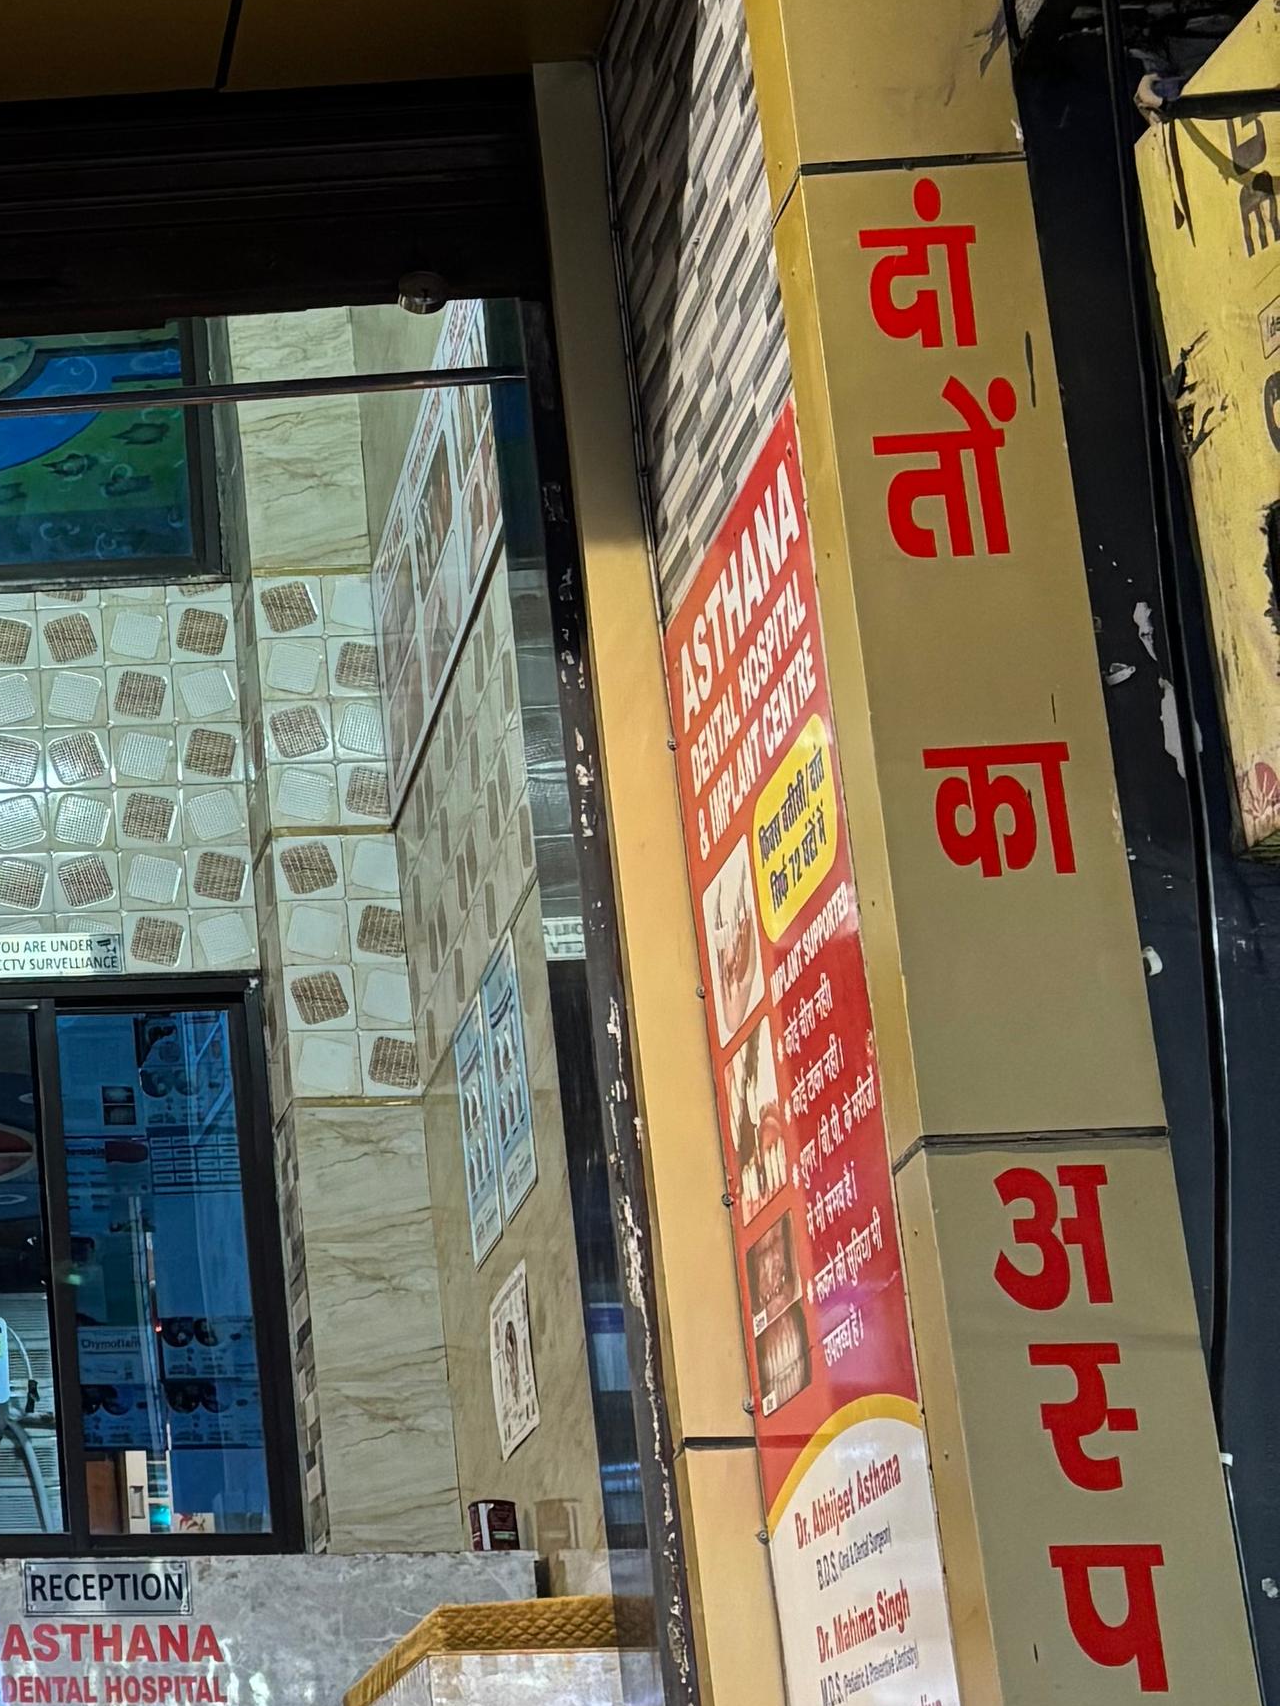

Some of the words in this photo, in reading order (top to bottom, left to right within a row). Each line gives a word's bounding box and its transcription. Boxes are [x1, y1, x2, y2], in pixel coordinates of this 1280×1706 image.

[680, 460, 800, 733] ASTHANA
[690, 684, 740, 797] DENTAL
[738, 570, 806, 716] HOSPITAL
[697, 808, 710, 861] &
[708, 718, 761, 844] IMPLANT
[762, 632, 816, 759] CENTRE
[923, 741, 1078, 878] का
[23, 941, 47, 953] ARE
[51, 939, 93, 952] UNDER
[812, 1477, 856, 1539] Abhijeet
[856, 1454, 902, 1510] Asthana
[29, 1571, 186, 1603] RECEPTION
[876, 1579, 911, 1634] Singh
[1, 1623, 225, 1664] ASTHANA
[2, 1675, 97, 1706] DENTAL
[105, 1674, 228, 1704] HOSPITAL
